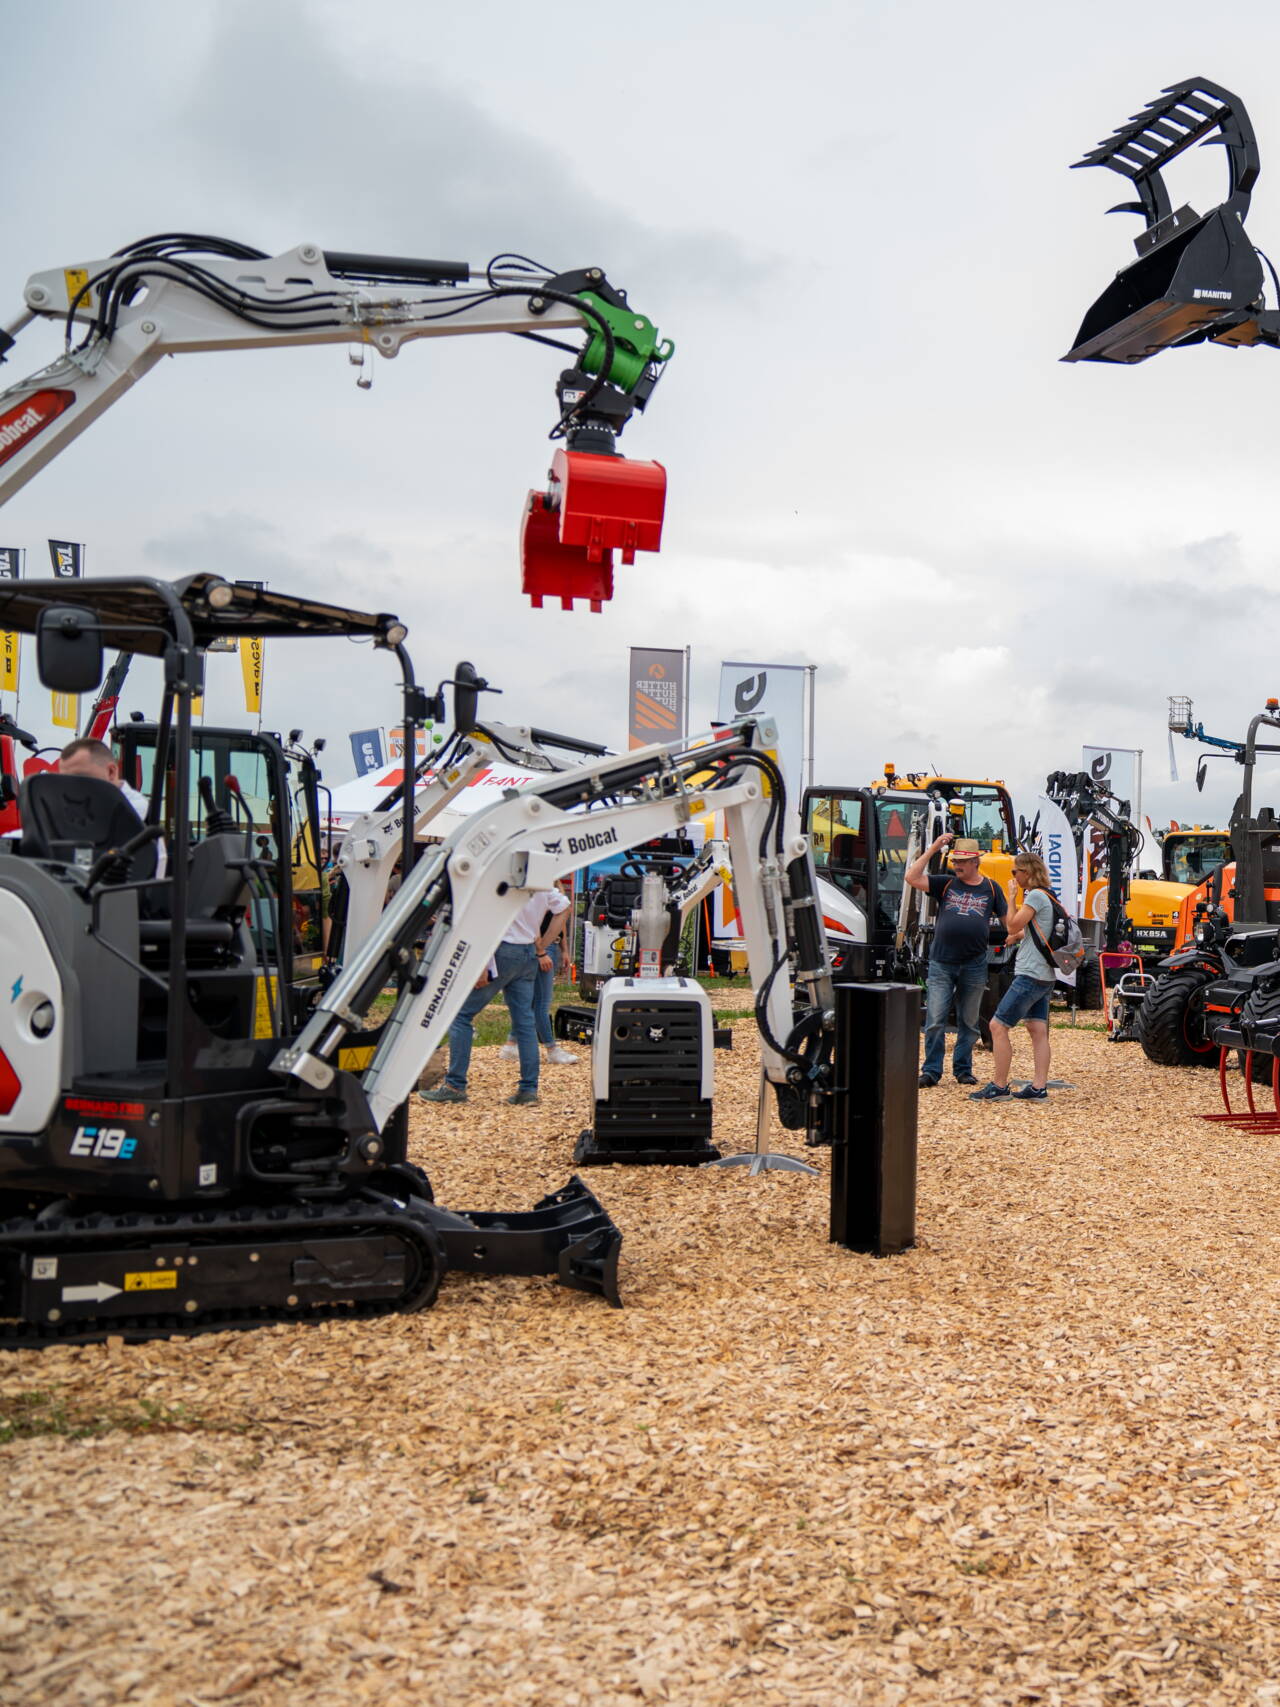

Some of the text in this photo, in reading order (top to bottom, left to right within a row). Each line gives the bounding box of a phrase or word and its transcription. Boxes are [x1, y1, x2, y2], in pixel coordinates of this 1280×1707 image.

[1202, 289, 1232, 300] MANITOU
[568, 826, 618, 854] Bobcat
[1136, 930, 1168, 938] HX85A
[420, 968, 454, 1029] BERNARD
[449, 939, 468, 968] FREI
[69, 1126, 139, 1160] E19e
